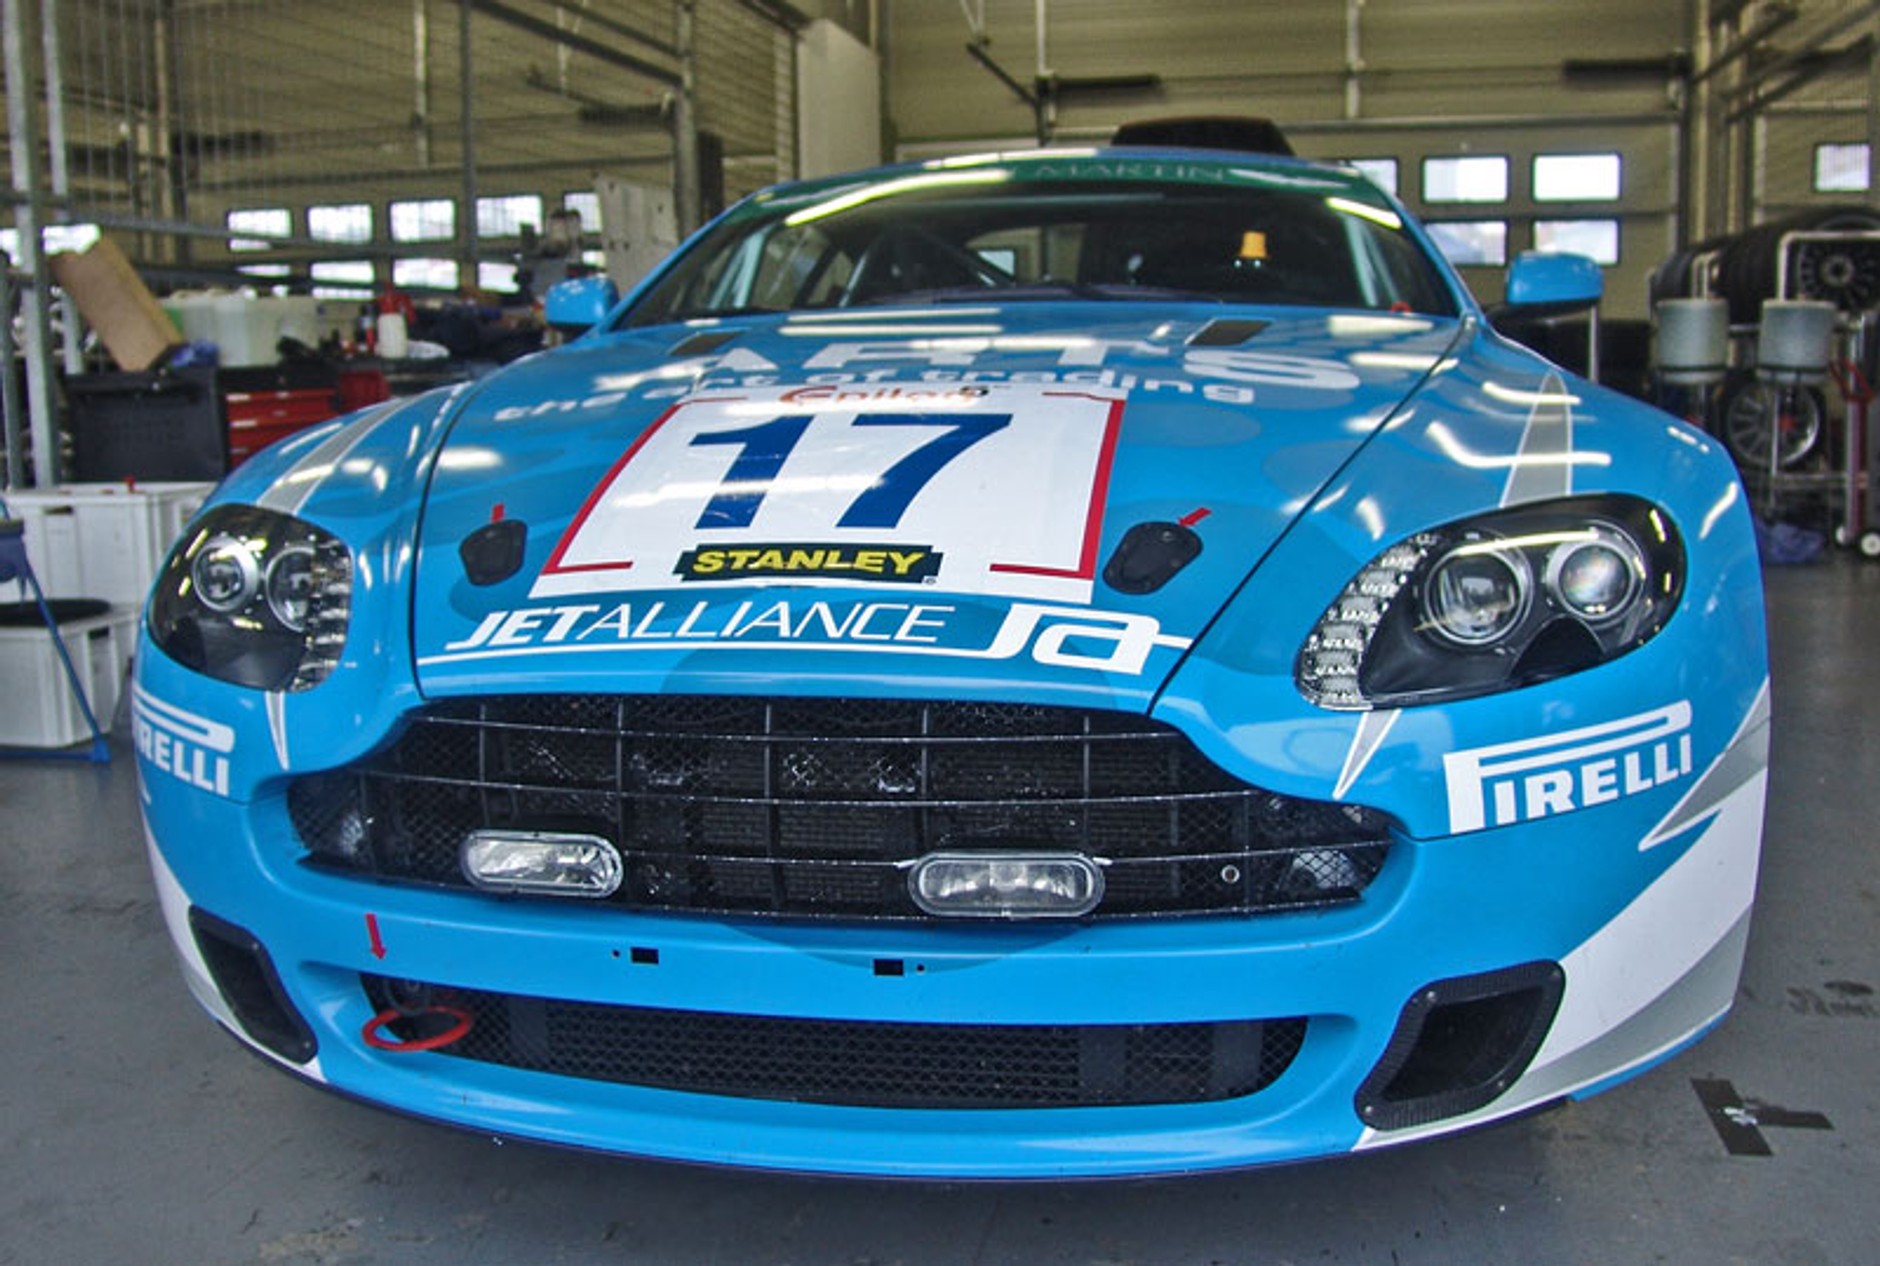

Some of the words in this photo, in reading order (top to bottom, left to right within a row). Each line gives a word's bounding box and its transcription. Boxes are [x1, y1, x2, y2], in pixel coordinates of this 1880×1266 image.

[688, 413, 1014, 529] 17
[692, 550, 925, 574] STANLEY
[1442, 699, 1692, 834] PIRELLI
